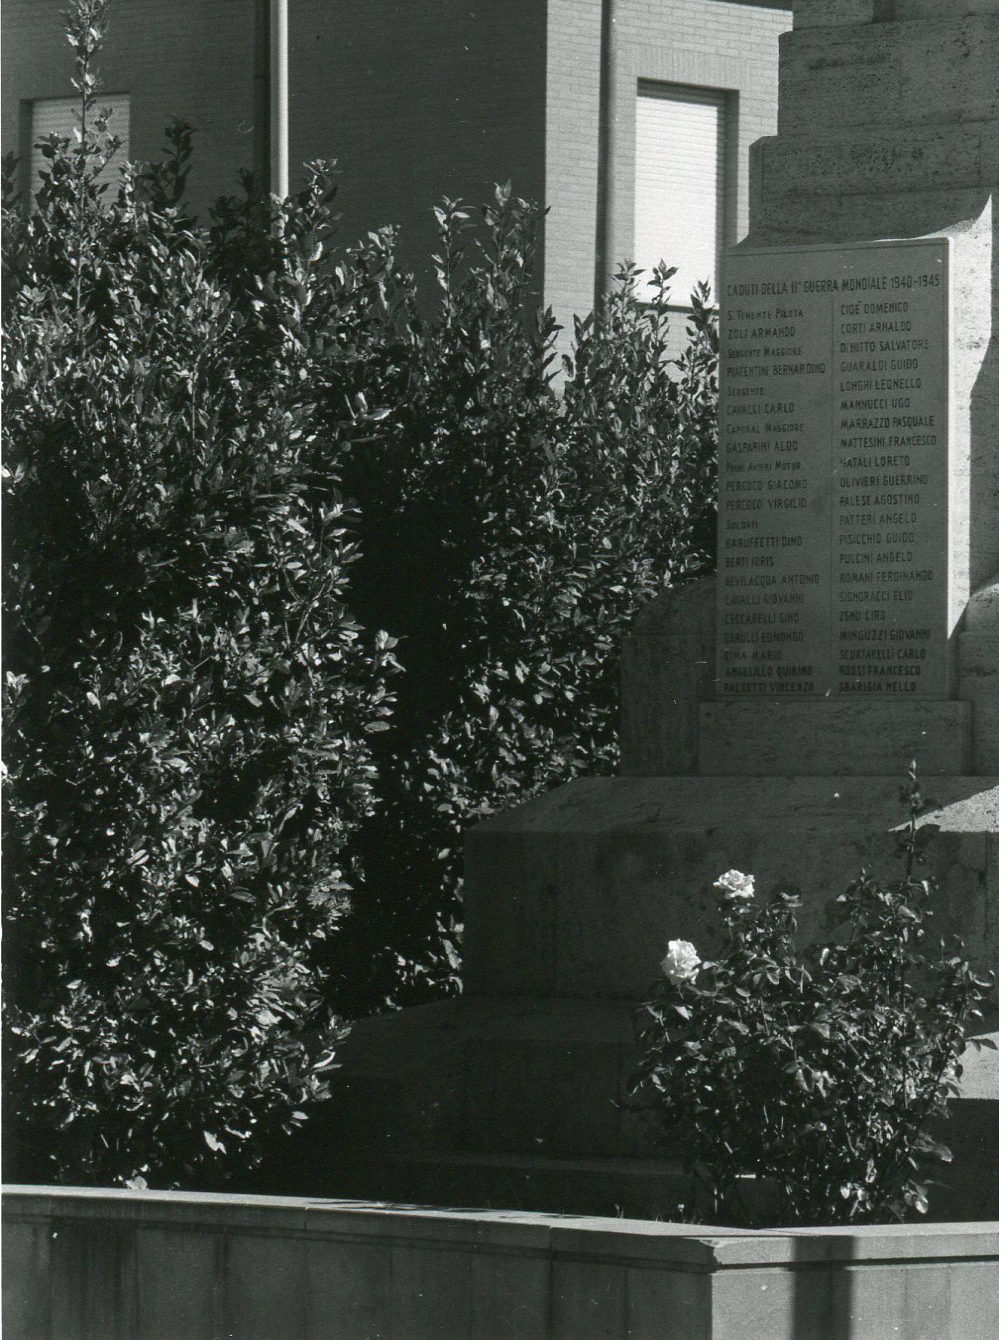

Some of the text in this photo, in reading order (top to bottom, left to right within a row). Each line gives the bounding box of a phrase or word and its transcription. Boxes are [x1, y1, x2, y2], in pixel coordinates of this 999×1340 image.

[727, 284, 758, 296] CADUTI
[761, 282, 787, 295] DELLA
[804, 280, 838, 292] GUERRA
[841, 276, 887, 291] MONDIALE
[890, 274, 940, 289] 1940-1945
[864, 301, 908, 314] DOMENICO
[738, 310, 771, 320] TENENTE
[775, 308, 803, 318] PILOTA
[751, 326, 795, 338] ARMANDO
[869, 321, 911, 332] ARNALDO
[850, 341, 875, 353] NITTO
[880, 339, 928, 351] SALVATORE
[728, 347, 801, 358] SERGENTE MAGGIORE
[727, 363, 825, 377] PIACENTINI BERNARDINO
[840, 358, 918, 372] GUARALDI GUIDO
[840, 378, 921, 391] LONGHI LEONELLO
[728, 387, 764, 396] SERGENTE
[727, 402, 794, 416] CAVALLI CARLO
[841, 398, 910, 410] MANNUCCI UGO
[765, 422, 803, 433] MAGGIORE
[840, 415, 935, 429] MARRAZZO PASQUALE
[726, 441, 798, 453] GASPARINI ALDO
[840, 435, 937, 448] MATTESINI FRANCESCO
[875, 456, 910, 466] LORETO
[768, 479, 807, 491] GIACOMO
[840, 475, 928, 487] OLIVIERI GUERRINO
[768, 498, 807, 509] VIRGILIO
[840, 494, 920, 506] PALESE AGOSTINO
[840, 513, 917, 526] PATTERI ANGELO
[782, 536, 802, 547] DINO
[886, 532, 914, 544] GUIDO
[876, 552, 912, 562] ANGELO
[725, 574, 820, 587] BEVILACQUA ANTONIO
[840, 570, 933, 584] ROMANI FERDINANDO
[725, 593, 804, 605] CAVALLI GIOVANNI
[893, 590, 913, 601] ELIO
[725, 612, 799, 625] CECCARELLI GINO
[840, 610, 885, 621] ZENO CIRO
[761, 631, 803, 643] EDMONDO
[840, 629, 931, 641] MINGUZZI GIOVANNI
[752, 650, 782, 661] MARIO
[898, 649, 926, 659] CARLO
[776, 665, 813, 678] QUIRINO
[868, 665, 921, 676] FRANCESCO
[886, 682, 916, 692] NELLO
